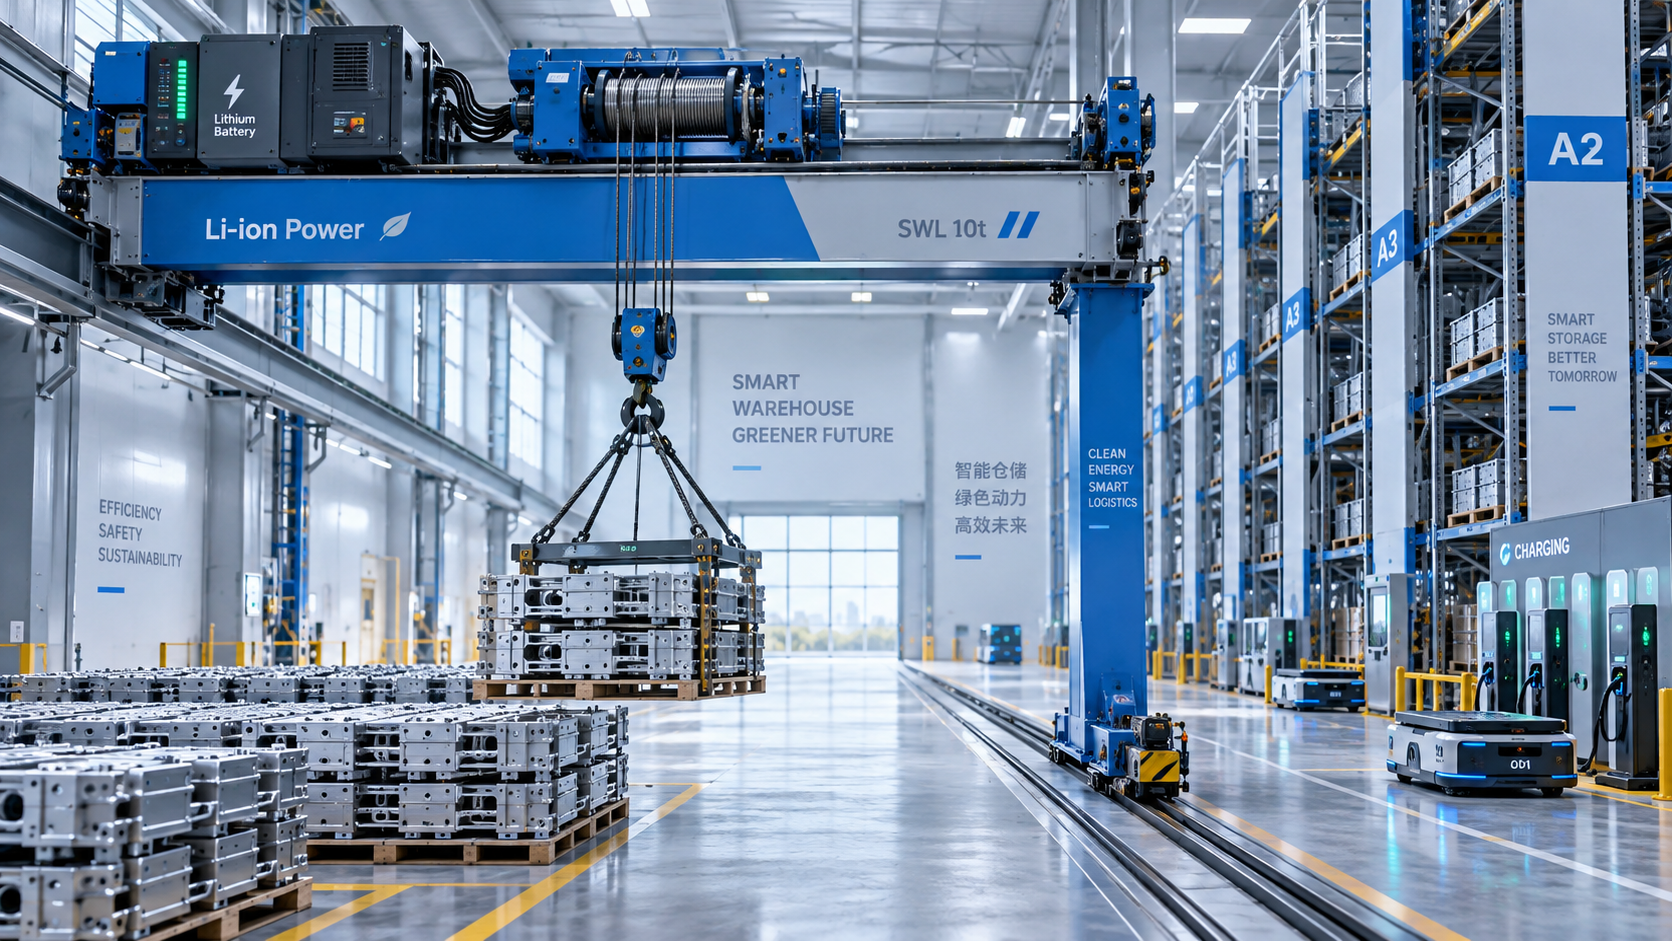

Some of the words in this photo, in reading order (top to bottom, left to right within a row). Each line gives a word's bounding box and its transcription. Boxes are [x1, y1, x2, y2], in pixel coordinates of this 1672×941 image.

[214, 113, 256, 125] Lithium
[214, 126, 256, 138] Battery
[1549, 132, 1604, 166] A2
[205, 217, 278, 240] Li-ion
[285, 218, 365, 240] Power
[898, 218, 947, 239] SWL
[953, 218, 987, 239] 10t
[1376, 229, 1398, 267] A3
[1285, 301, 1300, 333] A3
[1547, 313, 1596, 326] SMART
[1547, 332, 1608, 345] STORAGE
[1547, 351, 1597, 364] BETTER
[732, 373, 800, 390] SMART
[1547, 370, 1618, 383] TOMORROW
[732, 399, 854, 417] WAREHOUSE
[732, 426, 817, 443] GREENER
[822, 426, 894, 443] FUTURE
[1088, 448, 1126, 460] CLEAN
[955, 461, 1027, 480] 智能仓储
[1088, 464, 1135, 476] ENERGY
[1088, 481, 1129, 493] SMART
[955, 488, 1027, 507] 绿色动力
[1088, 497, 1138, 508] LOGISTICS
[99, 498, 162, 522] EFFICIENCY
[98, 522, 143, 542] SAFETY
[955, 516, 1027, 534] 高效未来
[98, 546, 183, 568] SUSTAINABILITY
[1514, 536, 1570, 560] CHARGING
